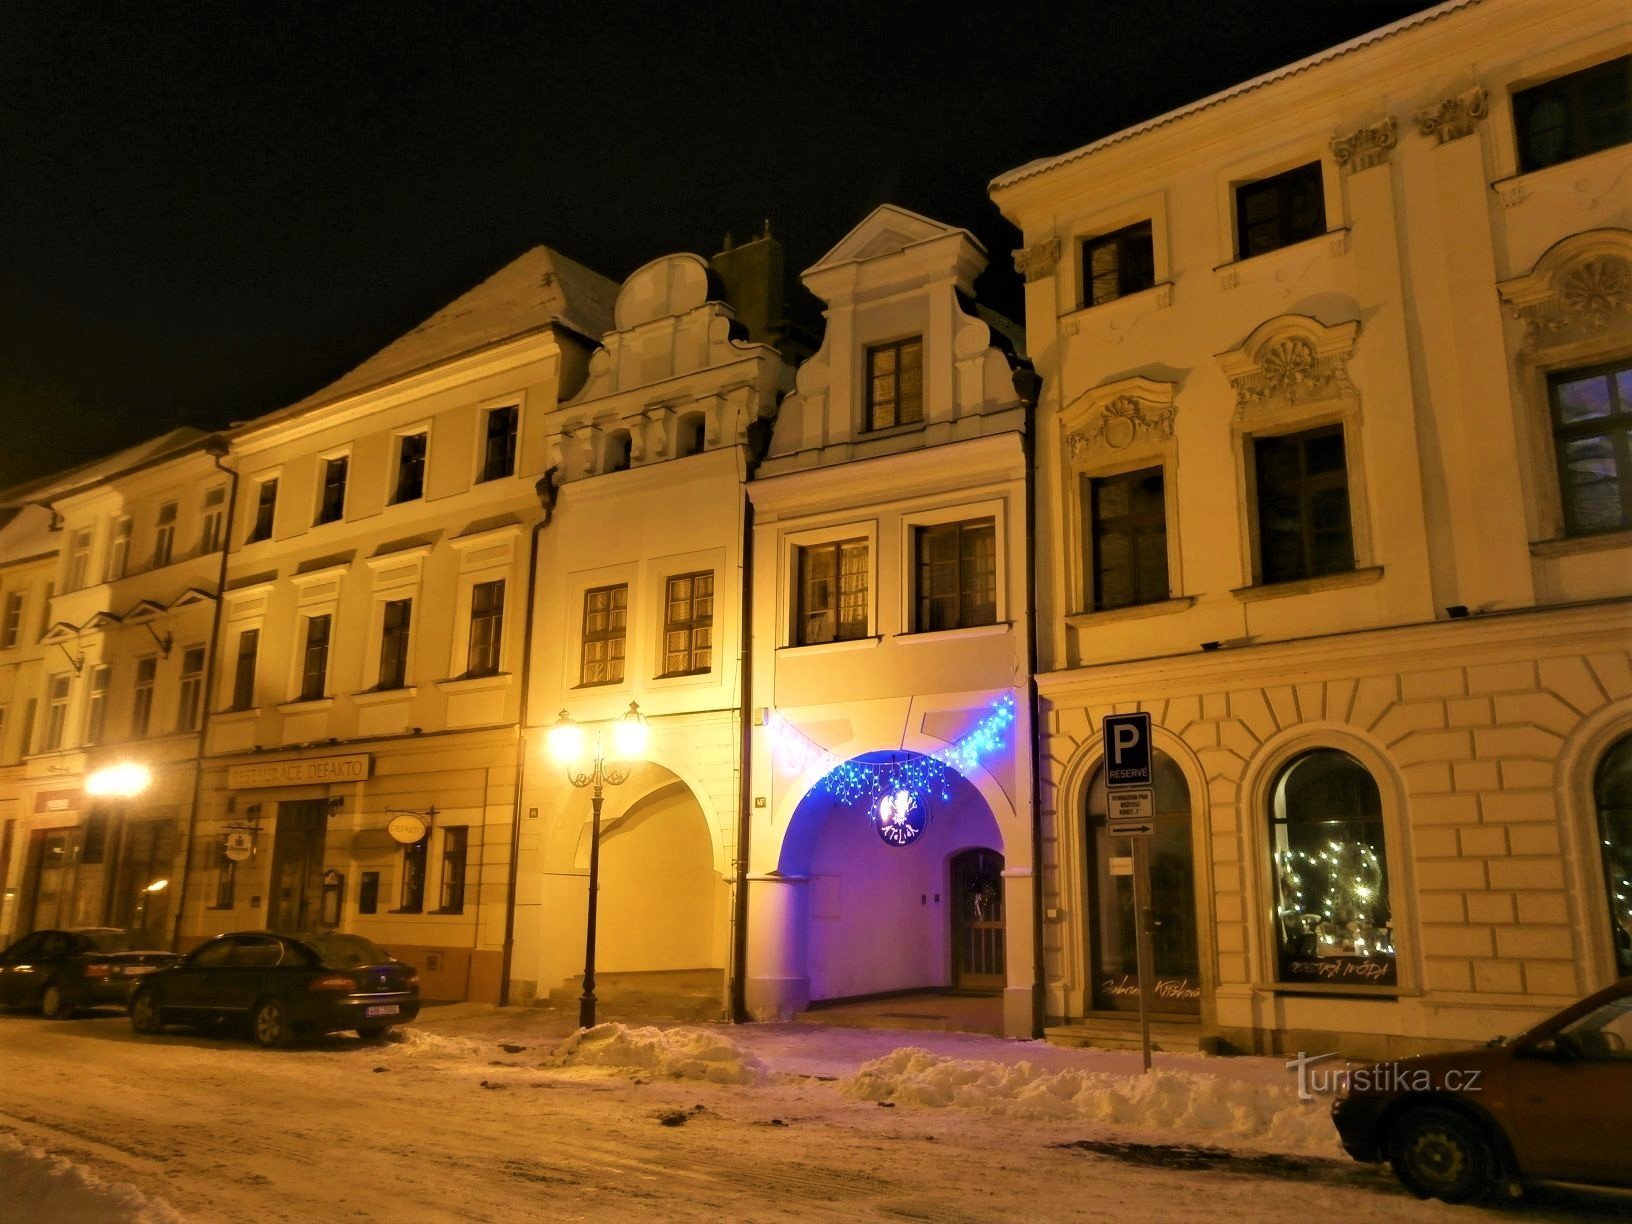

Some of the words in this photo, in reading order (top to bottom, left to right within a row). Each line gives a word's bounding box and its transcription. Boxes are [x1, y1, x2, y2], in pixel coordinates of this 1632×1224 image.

[1113, 724, 1139, 764] P
[232, 764, 303, 785] RESTAURACE
[308, 760, 363, 780] DEFAKTO
[390, 823, 424, 834] DEFAKTO
